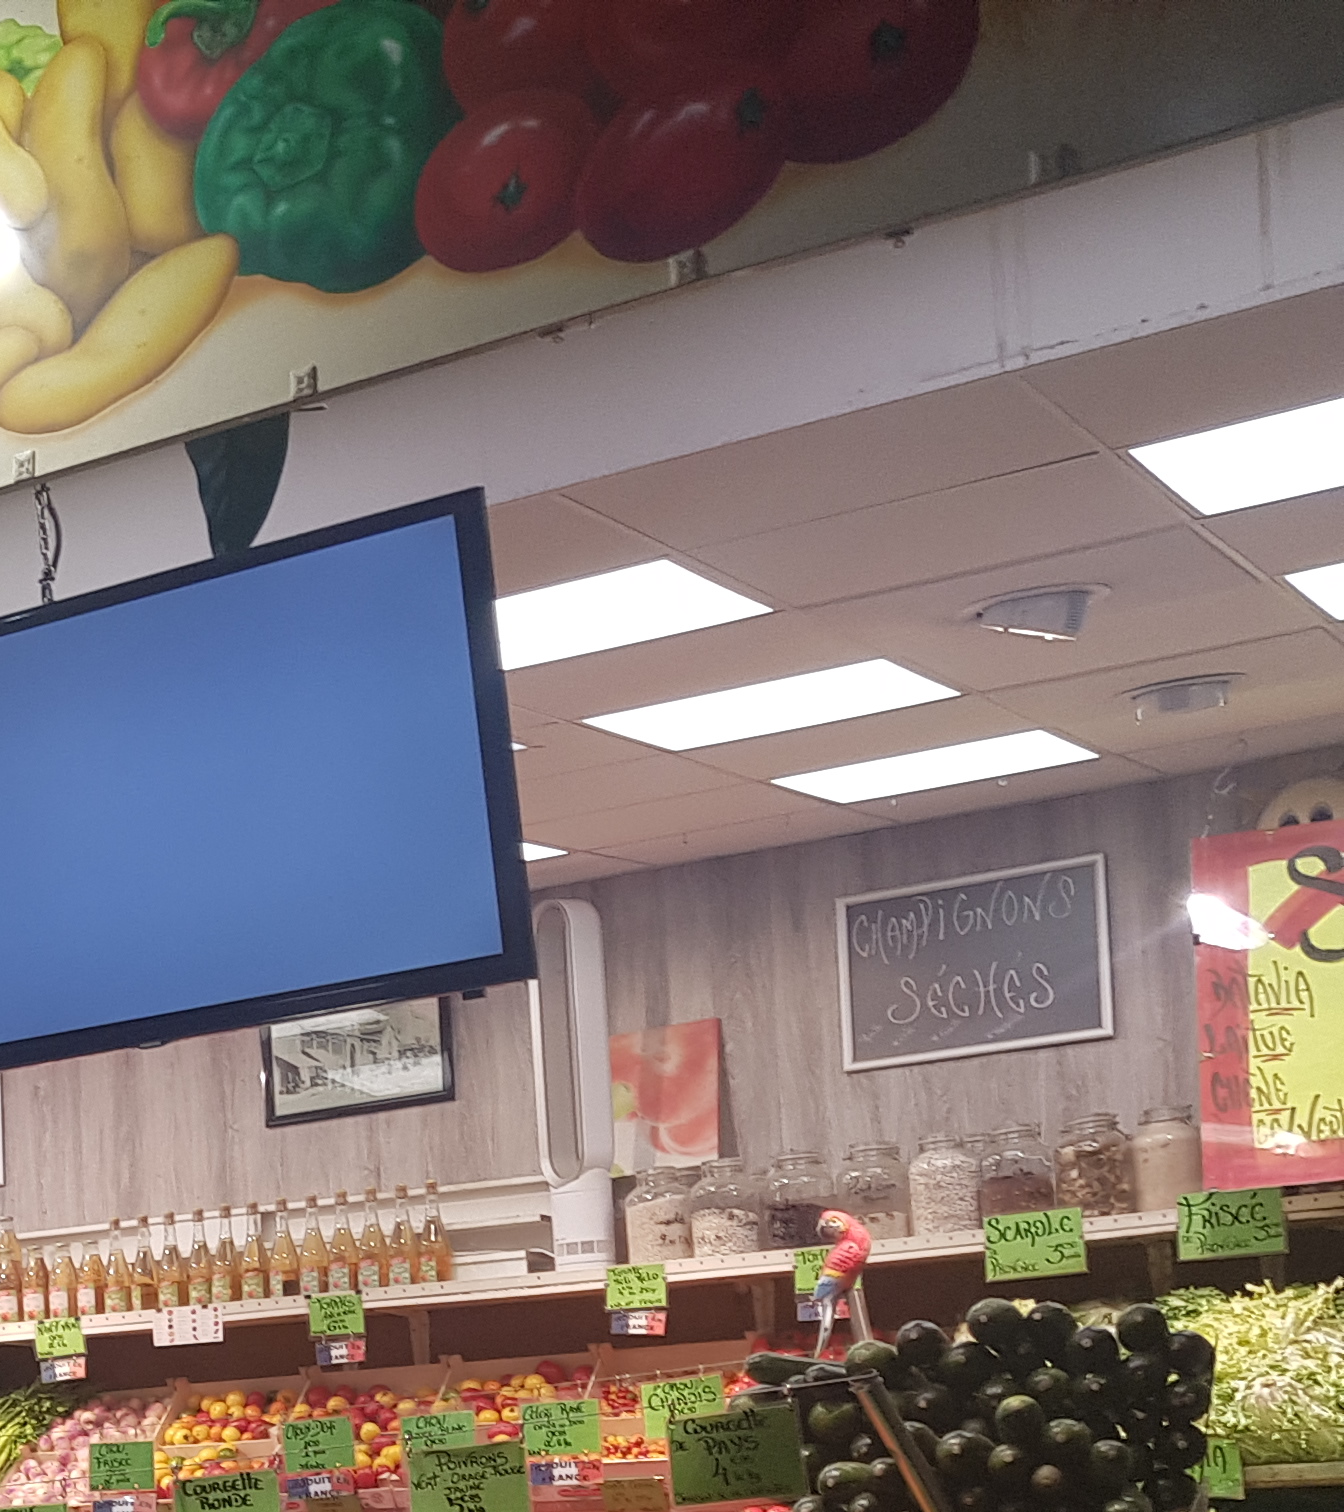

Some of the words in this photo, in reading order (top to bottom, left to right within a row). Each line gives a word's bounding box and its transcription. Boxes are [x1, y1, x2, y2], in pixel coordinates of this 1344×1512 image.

[853, 873, 1075, 965] CHAMPIGNONS
[986, 1212, 1074, 1247] SCAROLE
[424, 1450, 508, 1472] POIVRONS
[182, 1472, 264, 1497] COURGETTE
[195, 1493, 254, 1510] RONDE
